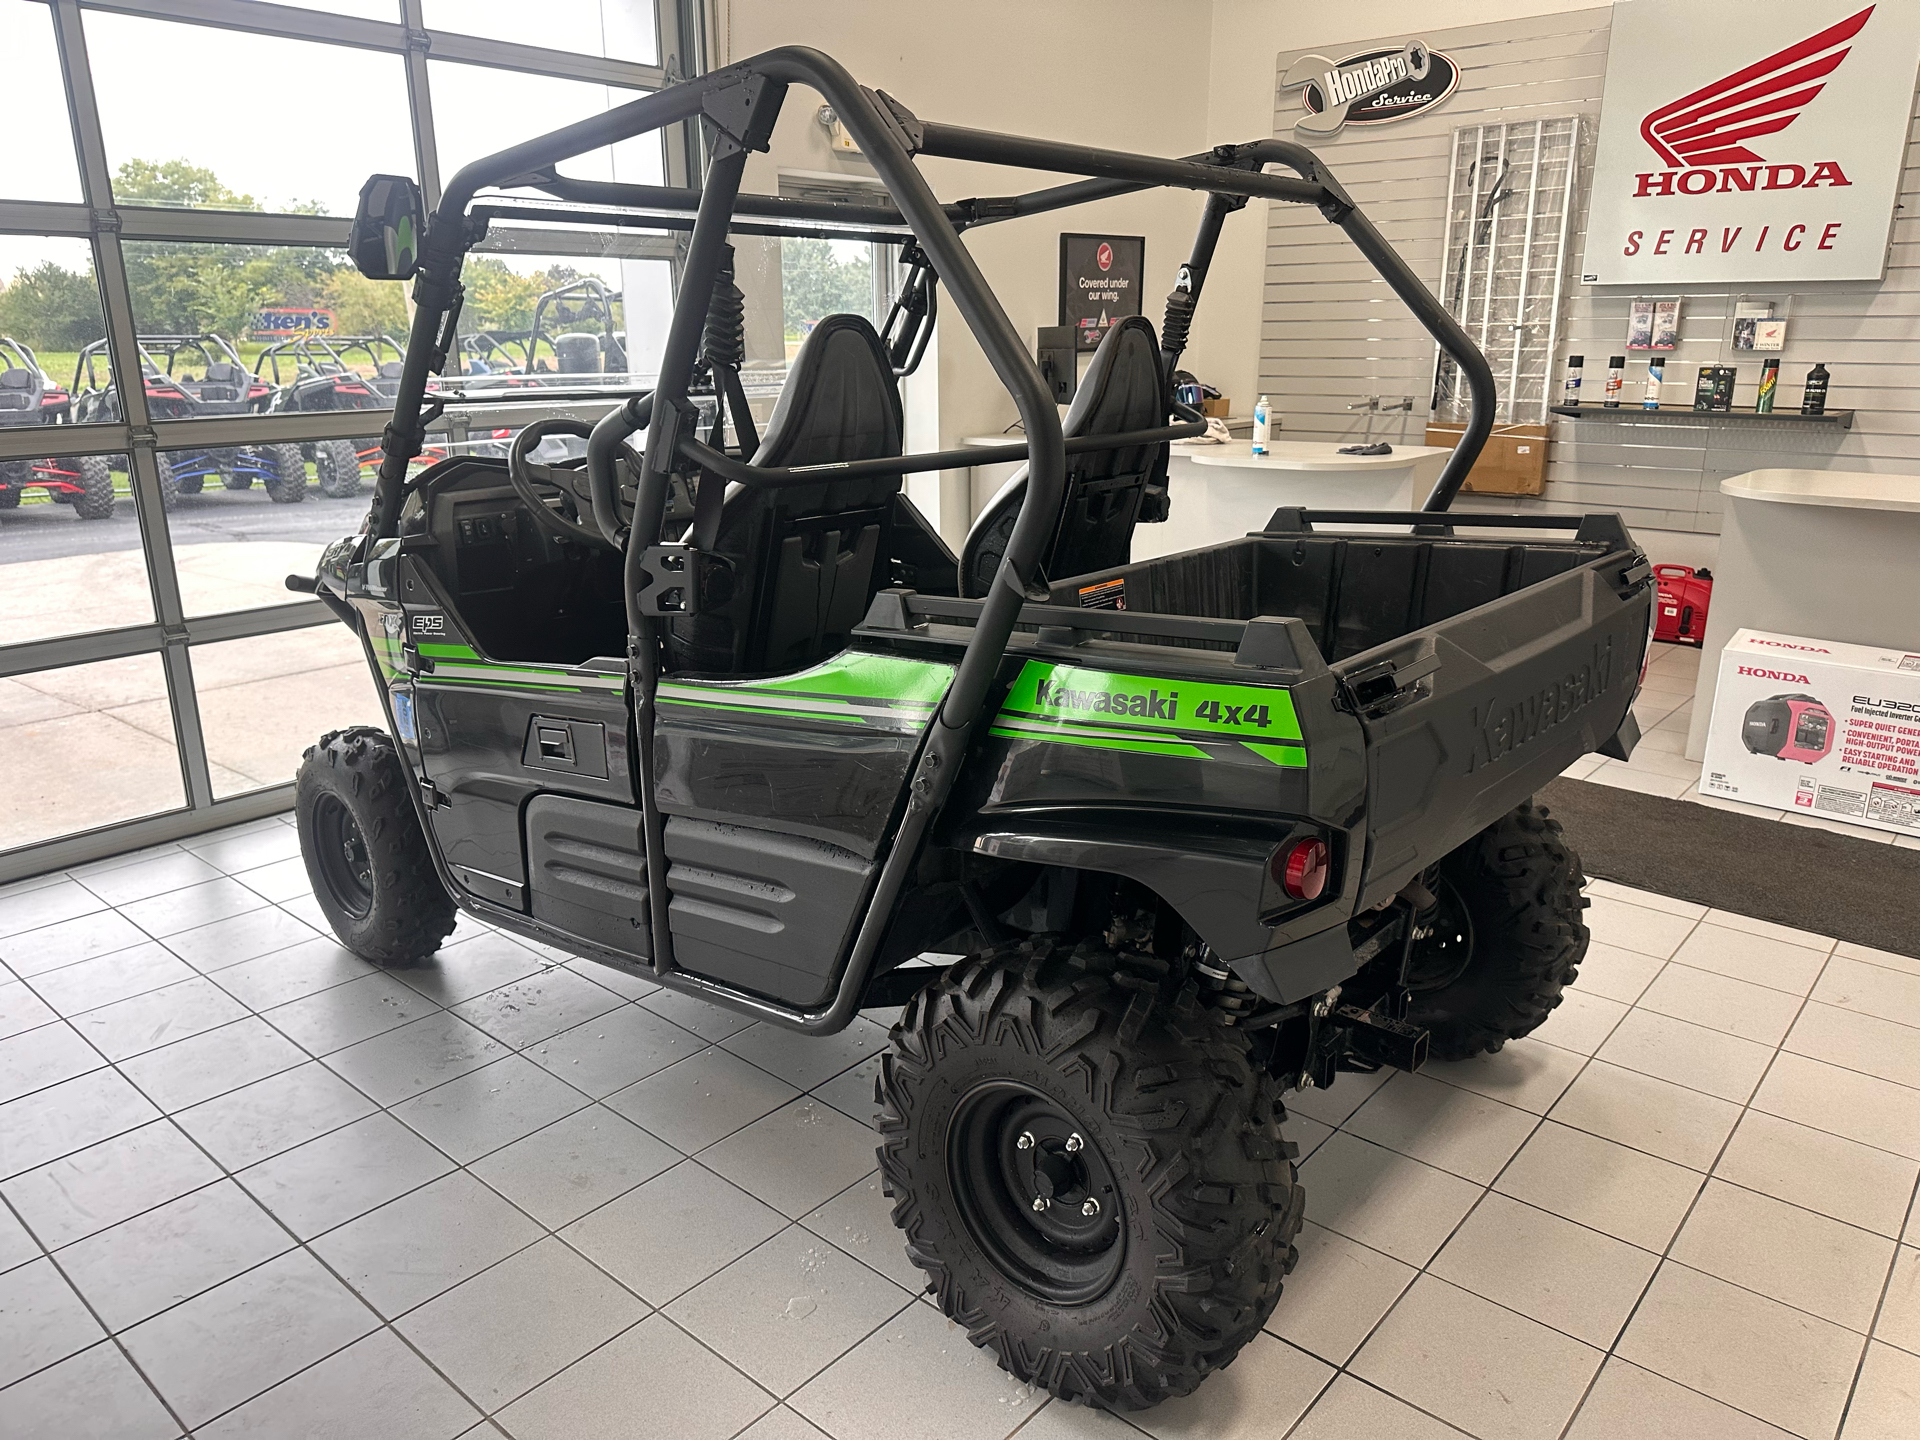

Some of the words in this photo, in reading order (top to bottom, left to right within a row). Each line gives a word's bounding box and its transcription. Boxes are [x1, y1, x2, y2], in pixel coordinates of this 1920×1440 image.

[1324, 57, 1408, 107] HondaPro
[1371, 90, 1433, 107] Service
[1632, 161, 1853, 198] HONDA
[1623, 223, 1842, 257] SERVICE
[1079, 277, 1109, 289] Covered
[1109, 278, 1129, 289] under
[1088, 291, 1100, 301] our
[1101, 289, 1120, 302] wing.
[263, 311, 330, 330] ken's
[289, 324, 335, 344] Sports
[1748, 637, 1832, 655] HONDA
[1736, 665, 1811, 685] HONDA
[1035, 678, 1180, 721] Kawasaki
[1195, 700, 1272, 728] 4x4
[1463, 634, 1613, 777] Kawasaki
[1851, 705, 1863, 713] Fuel
[1864, 707, 1889, 718] Injected
[1889, 711, 1913, 722] Inverter
[1849, 718, 1873, 729] SUPER
[1875, 722, 1897, 733] QUIET
[1845, 737, 1895, 752] HIGH-OUTPUT
[1847, 729, 1894, 744] CONVENIENT,
[1842, 755, 1876, 768] RELIABLE
[1877, 761, 1919, 776] OPERATION
[1843, 747, 1862, 757] EASY
[1862, 750, 1898, 763] STARTING
[1899, 757, 1915, 767] AND
